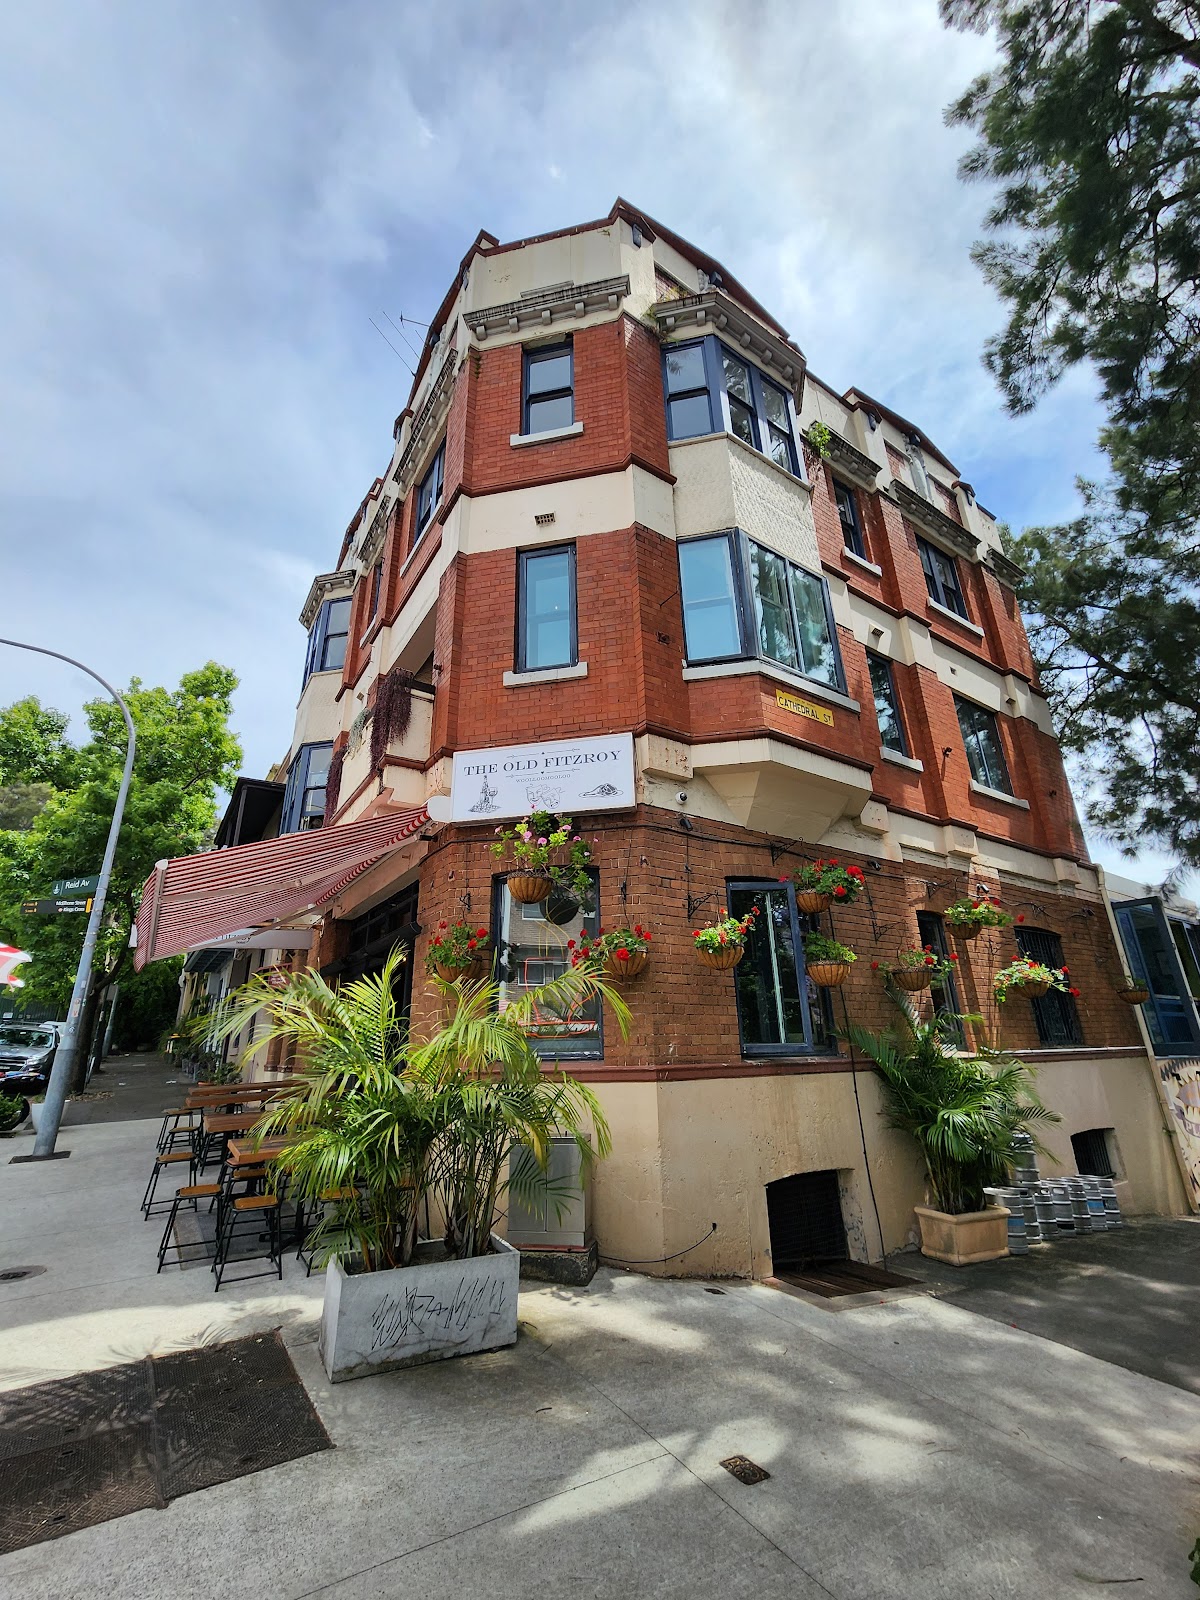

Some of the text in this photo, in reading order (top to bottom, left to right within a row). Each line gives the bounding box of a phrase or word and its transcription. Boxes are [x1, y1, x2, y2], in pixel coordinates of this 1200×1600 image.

[778, 696, 820, 720] CATHEDRAL
[823, 713, 831, 723] ST
[464, 750, 622, 776] THE OLD FITZROY
[65, 879, 90, 889] Reid Av
